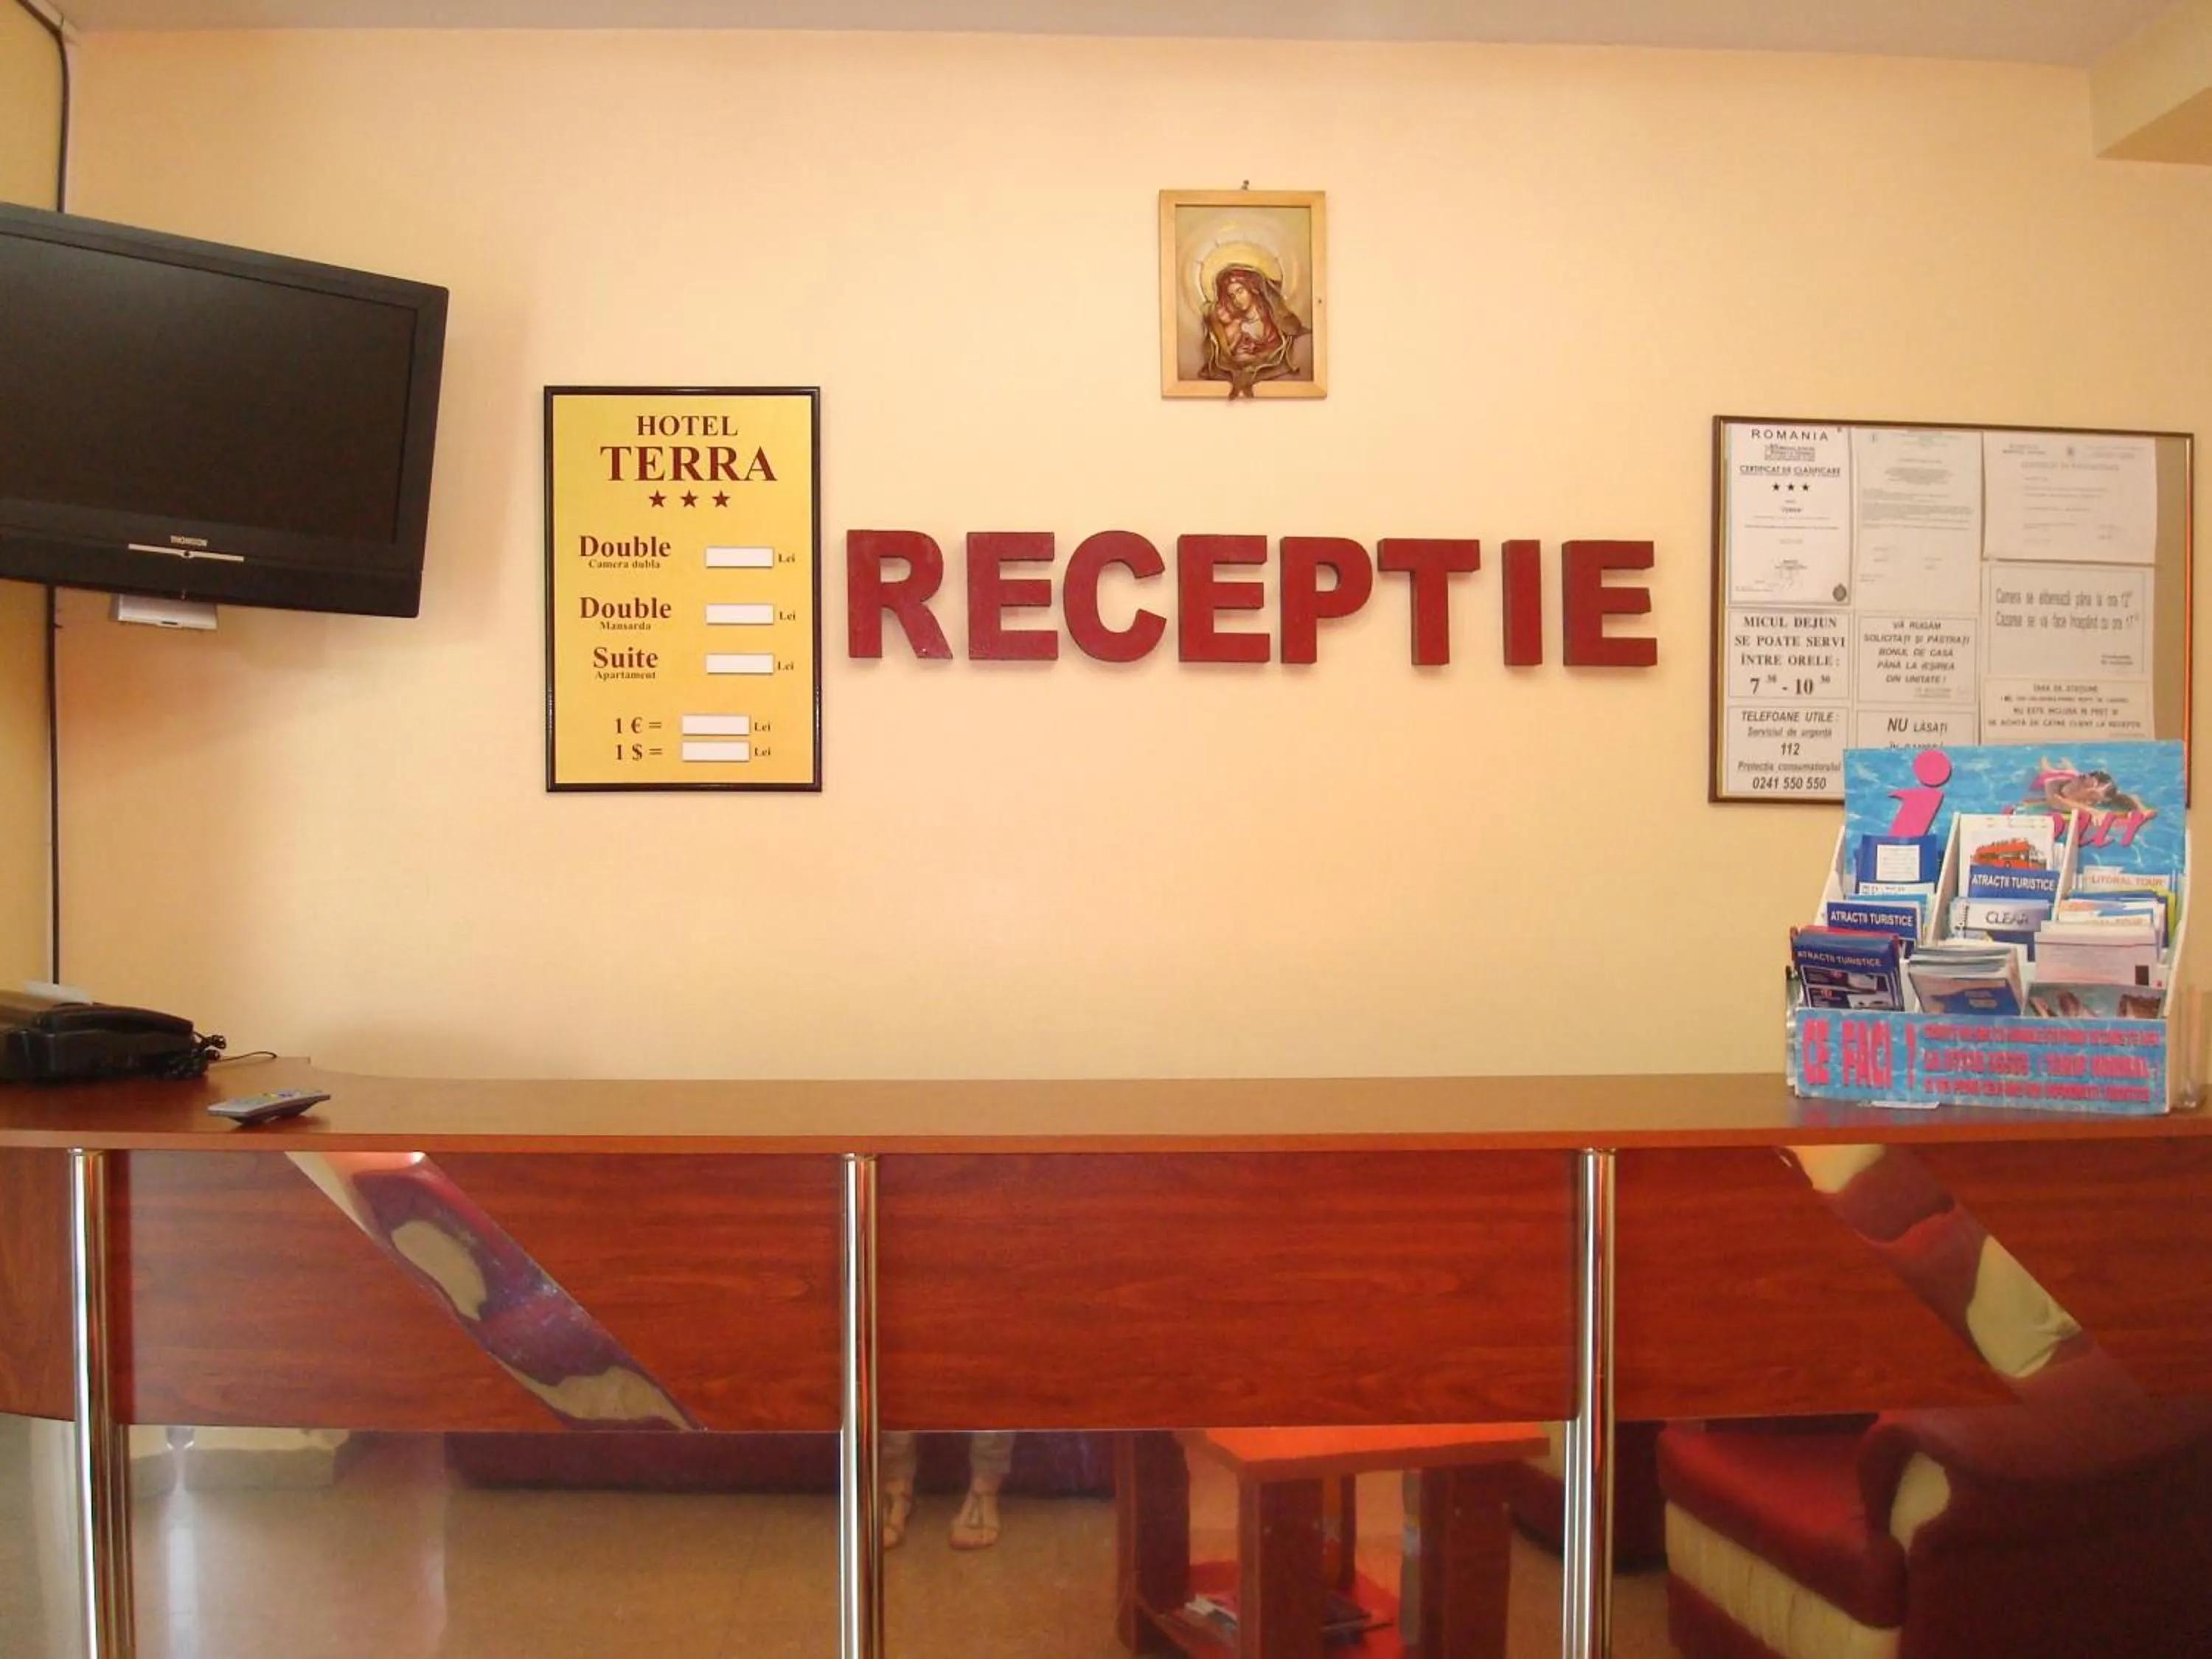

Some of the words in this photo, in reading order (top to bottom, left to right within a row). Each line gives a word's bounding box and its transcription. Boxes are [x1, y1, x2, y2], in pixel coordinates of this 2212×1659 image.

[636, 415, 738, 437] HOTEL
[599, 445, 778, 481] TERRA
[579, 535, 671, 557] Double
[588, 560, 629, 569] Camera
[632, 559, 661, 569] dubla
[778, 553, 796, 564] Lei
[846, 529, 1658, 667] RECEPTIE
[580, 597, 672, 619] Double
[779, 611, 796, 622] Lei
[1743, 616, 1787, 627] MICUL
[1793, 616, 1837, 628] DEJUN
[599, 621, 651, 631] Mansarda
[1734, 636, 1751, 647] SE
[1757, 636, 1799, 647] POATE
[1806, 637, 1845, 647] SERVI
[593, 647, 658, 669] Suite
[777, 661, 794, 672] Lei
[1905, 661, 1917, 669] LA
[595, 670, 656, 681] Apartament
[1750, 678, 1760, 694] 7
[1795, 678, 1814, 695] 10
[1742, 711, 1800, 722] TELEFOANE
[615, 718, 623, 734] 1
[631, 717, 642, 734] €
[754, 722, 771, 732] Lei
[1888, 717, 1909, 732] NU
[1787, 728, 1797, 737] de
[615, 744, 623, 760] 1
[632, 743, 643, 762] $
[754, 747, 771, 757] Lei
[1781, 742, 1800, 755] 112
[1753, 777, 1778, 789] 0241
[1783, 777, 1803, 789] 550
[1806, 778, 1827, 790] 550
[2011, 876, 2055, 891] TURISTICE
[1870, 913, 1913, 928] TURISTICE
